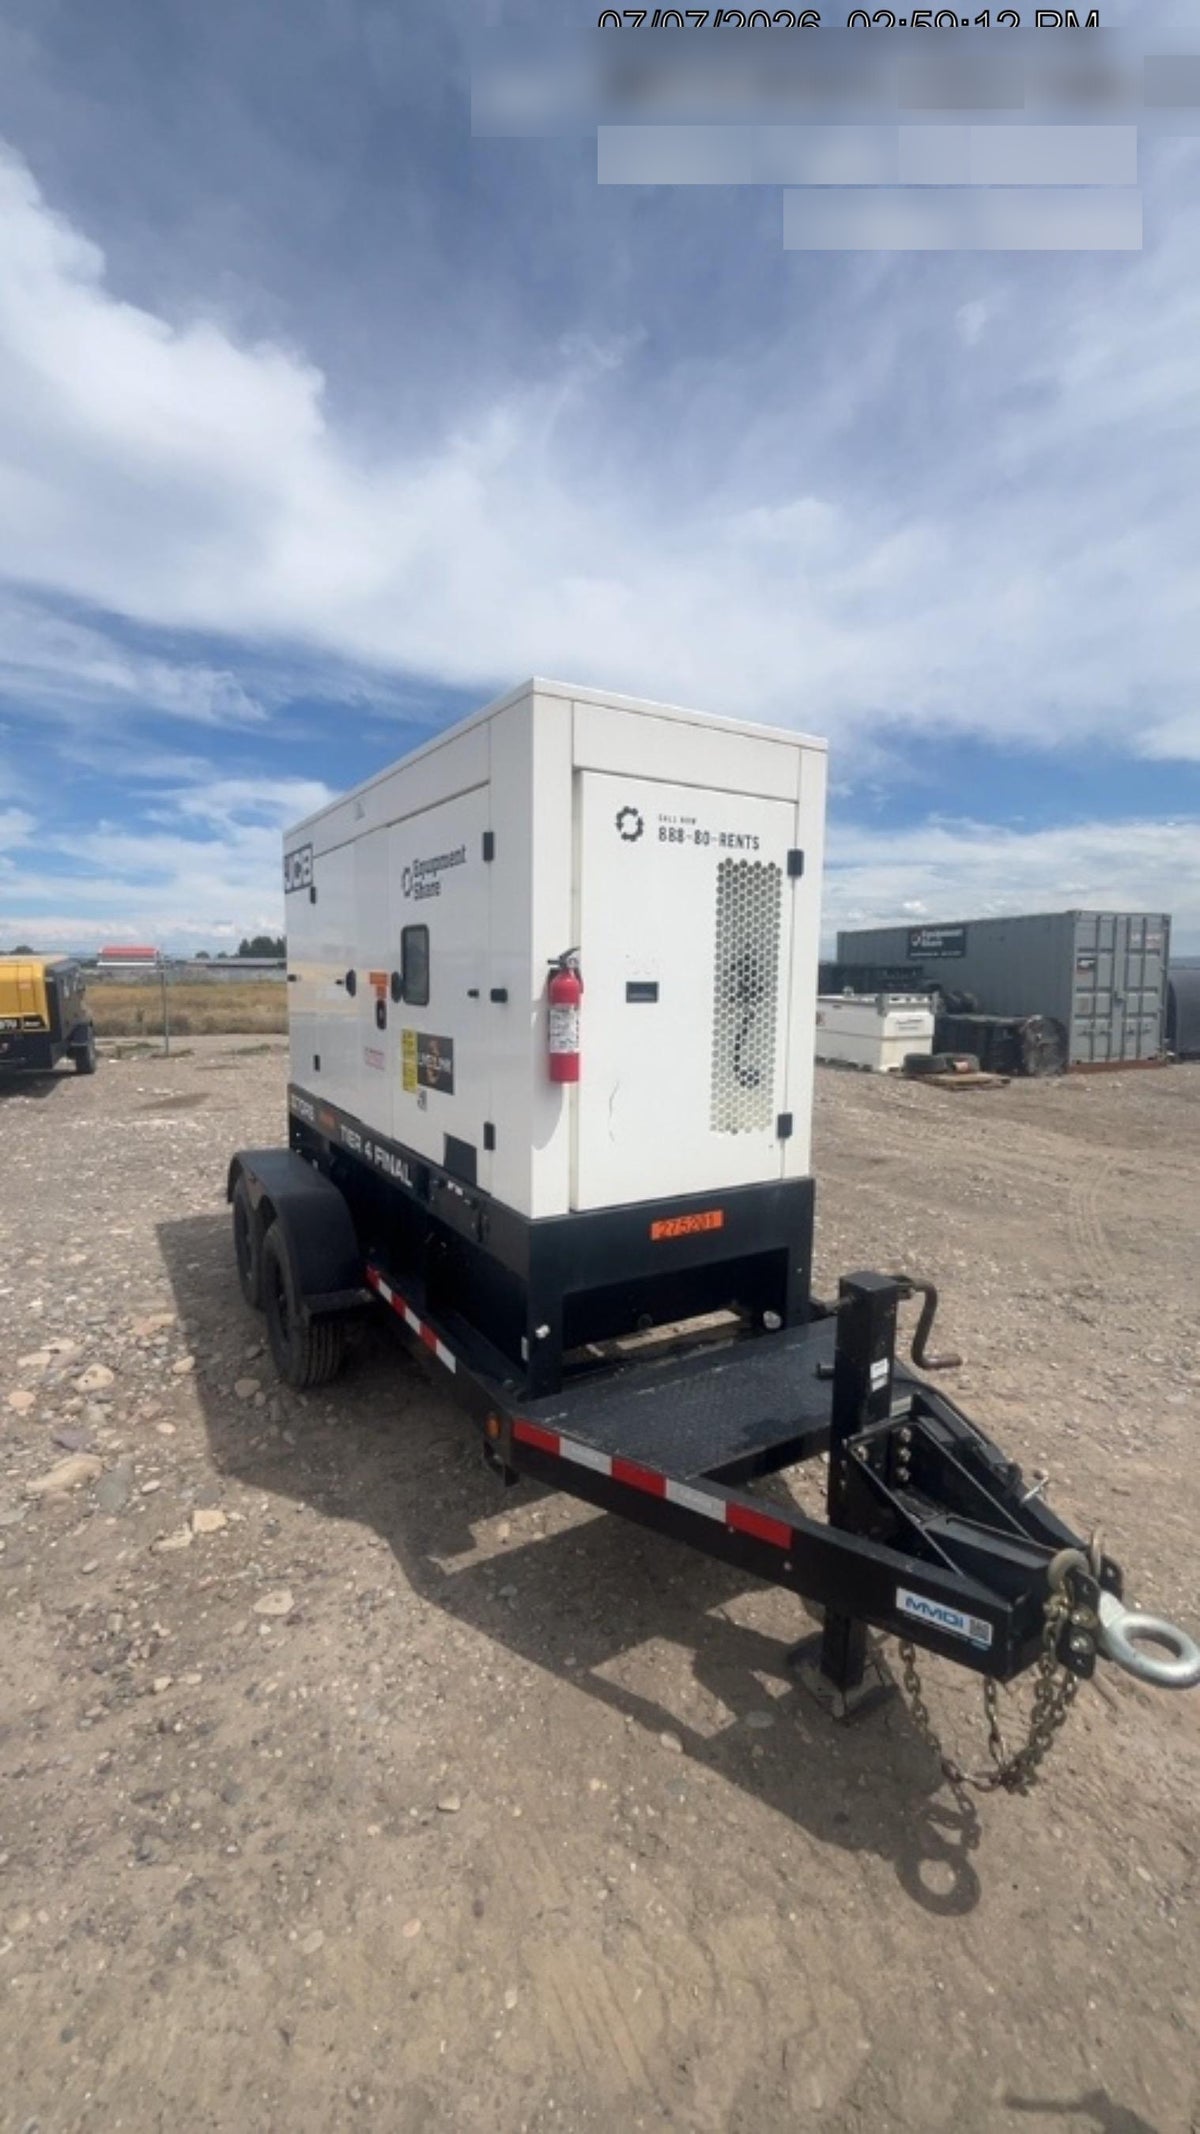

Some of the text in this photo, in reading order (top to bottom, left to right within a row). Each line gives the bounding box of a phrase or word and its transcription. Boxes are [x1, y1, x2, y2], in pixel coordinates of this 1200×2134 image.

[413, 844, 466, 879] Equipment
[414, 881, 440, 900] Share
[341, 1123, 362, 1153] TIER
[364, 1140, 373, 1161] 4
[374, 1144, 413, 1188] FINAL
